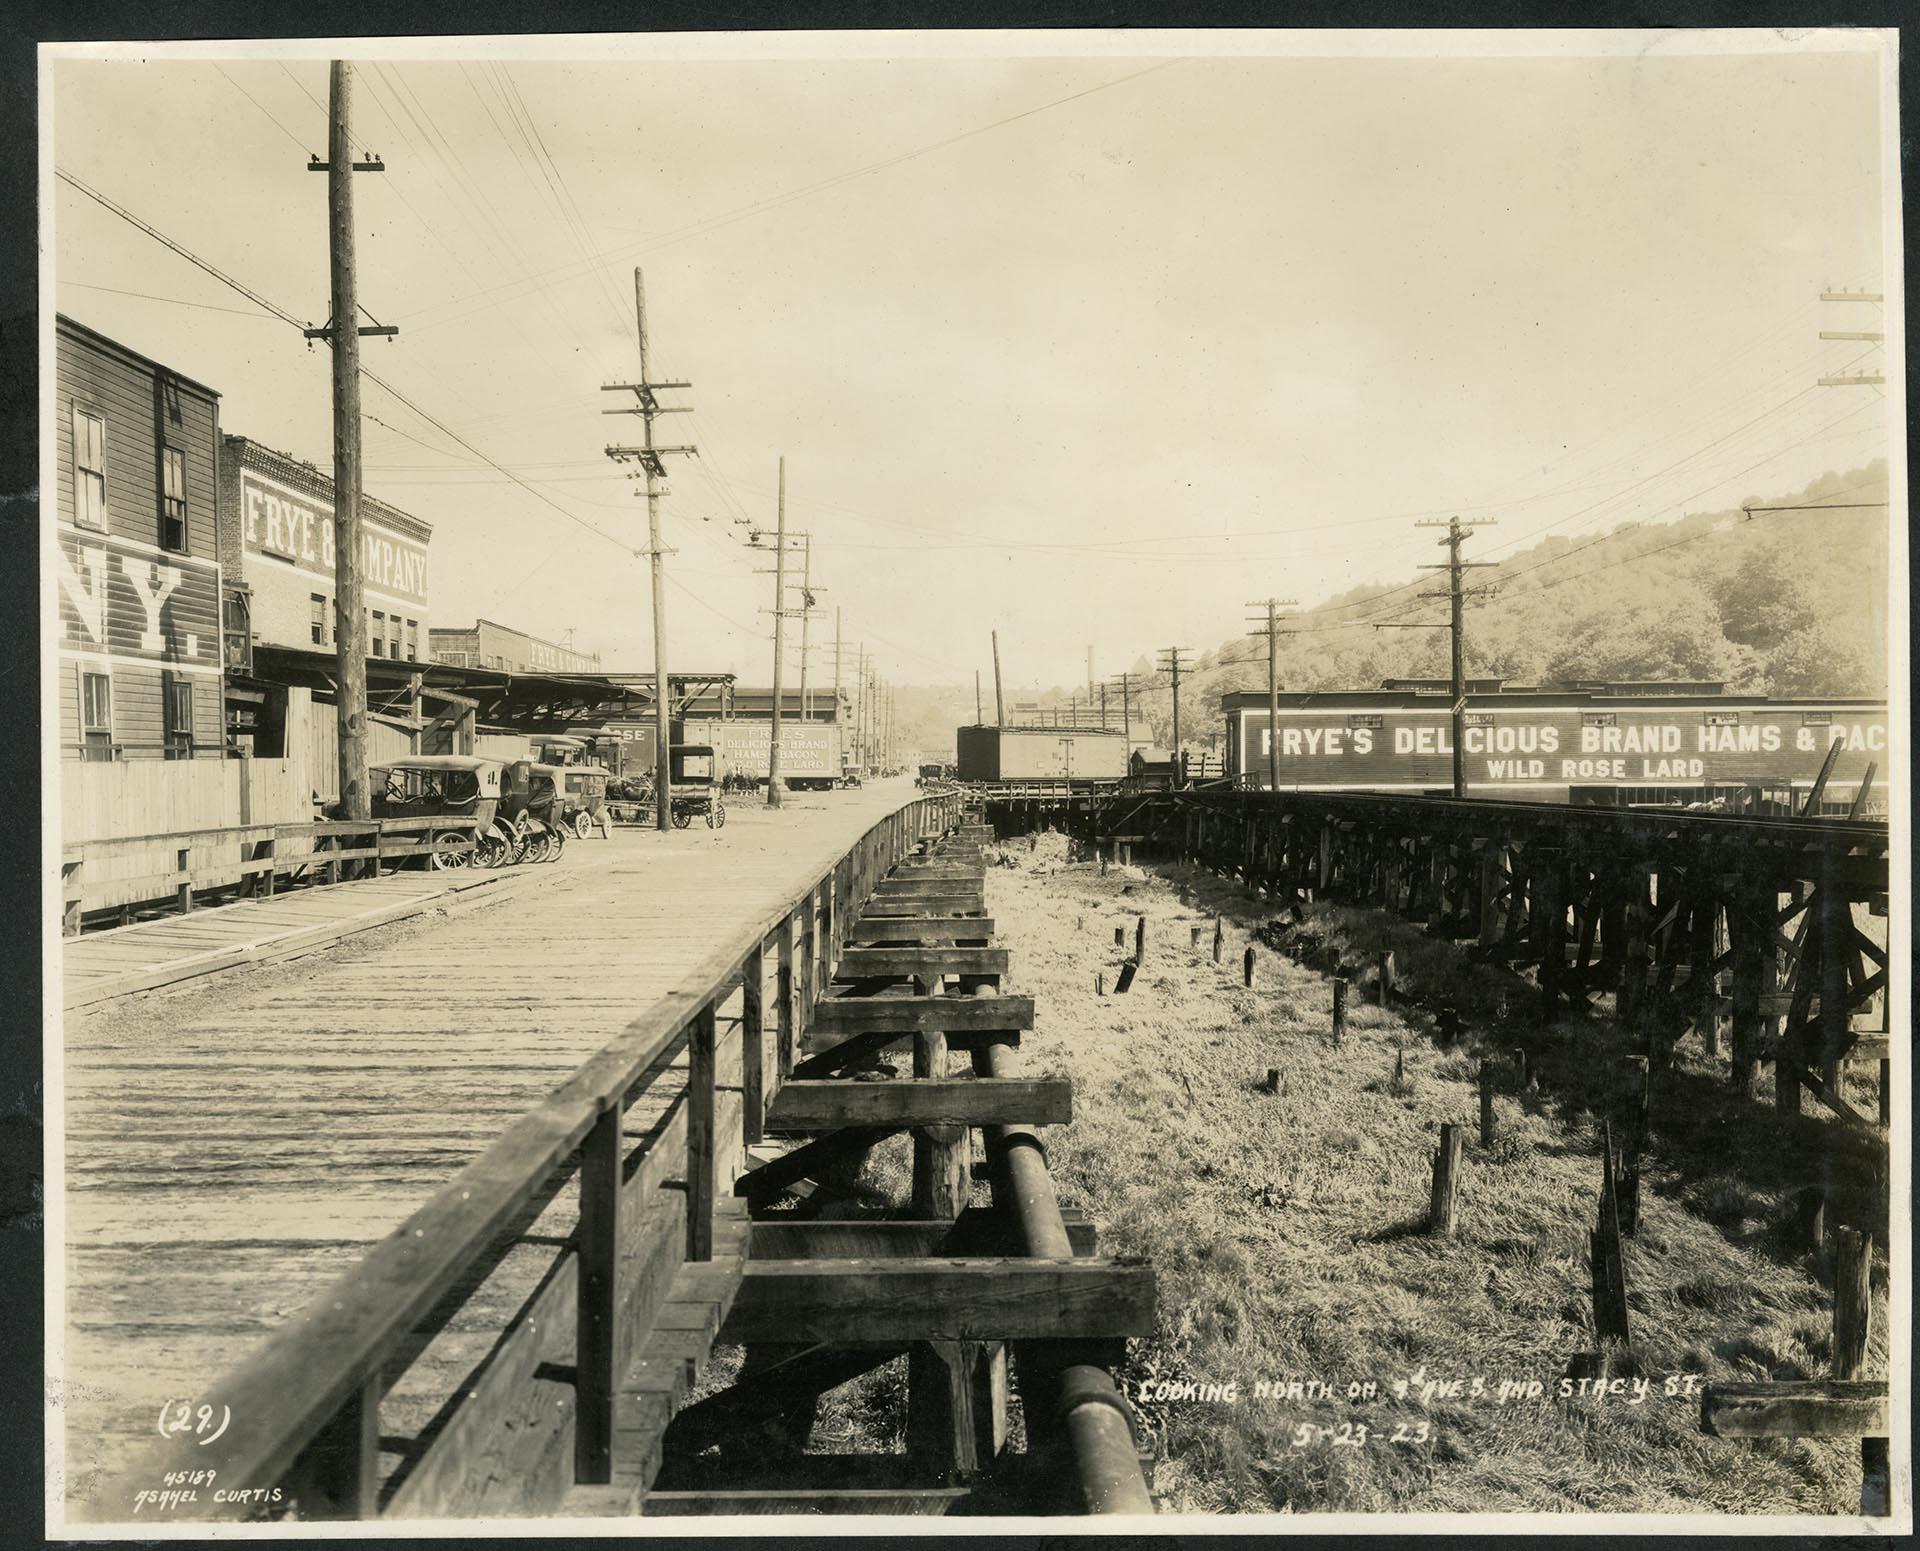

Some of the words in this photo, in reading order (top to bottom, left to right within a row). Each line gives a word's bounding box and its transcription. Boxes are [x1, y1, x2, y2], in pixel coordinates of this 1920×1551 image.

[246, 486, 315, 562] FRYE
[727, 740, 785, 749] DELICIOS
[790, 740, 828, 749] BRAND
[1262, 728, 1373, 754] FRYE'S
[1395, 726, 1559, 754] DELCIOUS
[1581, 726, 1681, 753] BRAND
[1699, 725, 1781, 752] HAMS
[1796, 727, 1816, 751] &
[734, 750, 766, 759] HAMS
[780, 750, 818, 759] BACON
[793, 760, 824, 769] LARD
[1487, 760, 1544, 778] WILD
[1561, 760, 1626, 778] ROSE
[1643, 759, 1704, 778] LARD
